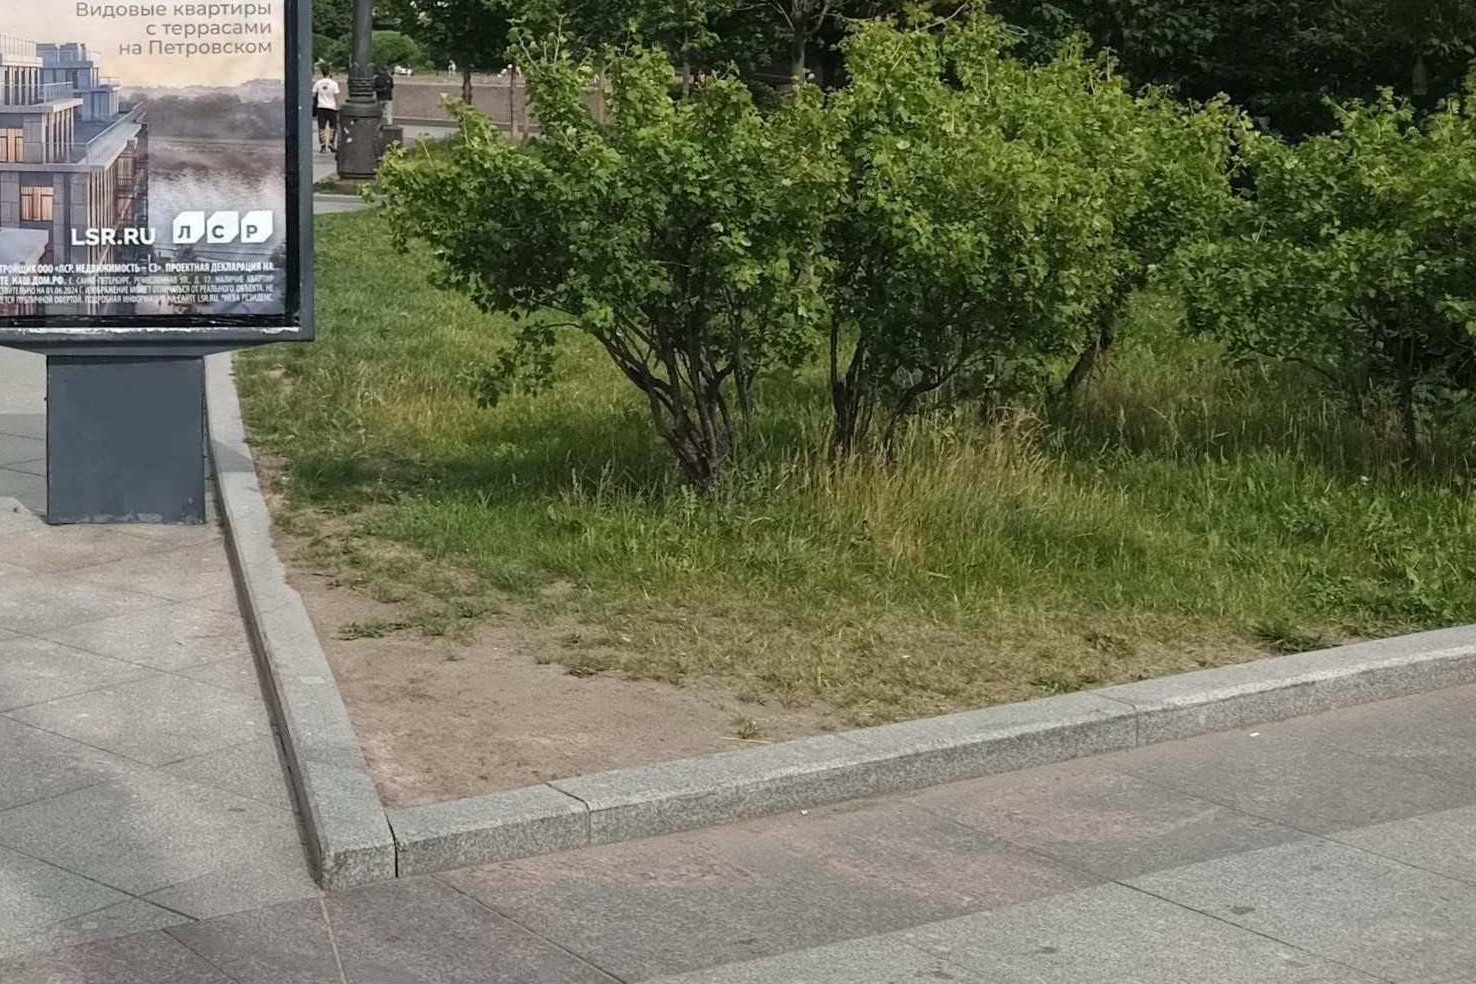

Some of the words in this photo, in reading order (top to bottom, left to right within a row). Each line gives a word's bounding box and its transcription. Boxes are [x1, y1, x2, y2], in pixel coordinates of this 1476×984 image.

[76, 1, 167, 18] Видовые
[173, 2, 272, 18] квартиры
[162, 22, 272, 39] террасами
[119, 42, 142, 55] на
[149, 40, 272, 58] Петровском
[71, 227, 156, 246] LSR.RU
[37, 264, 54, 274] ООО
[211, 261, 262, 273] ДЕКЛАРАЦИЯ
[262, 261, 274, 271] НА
